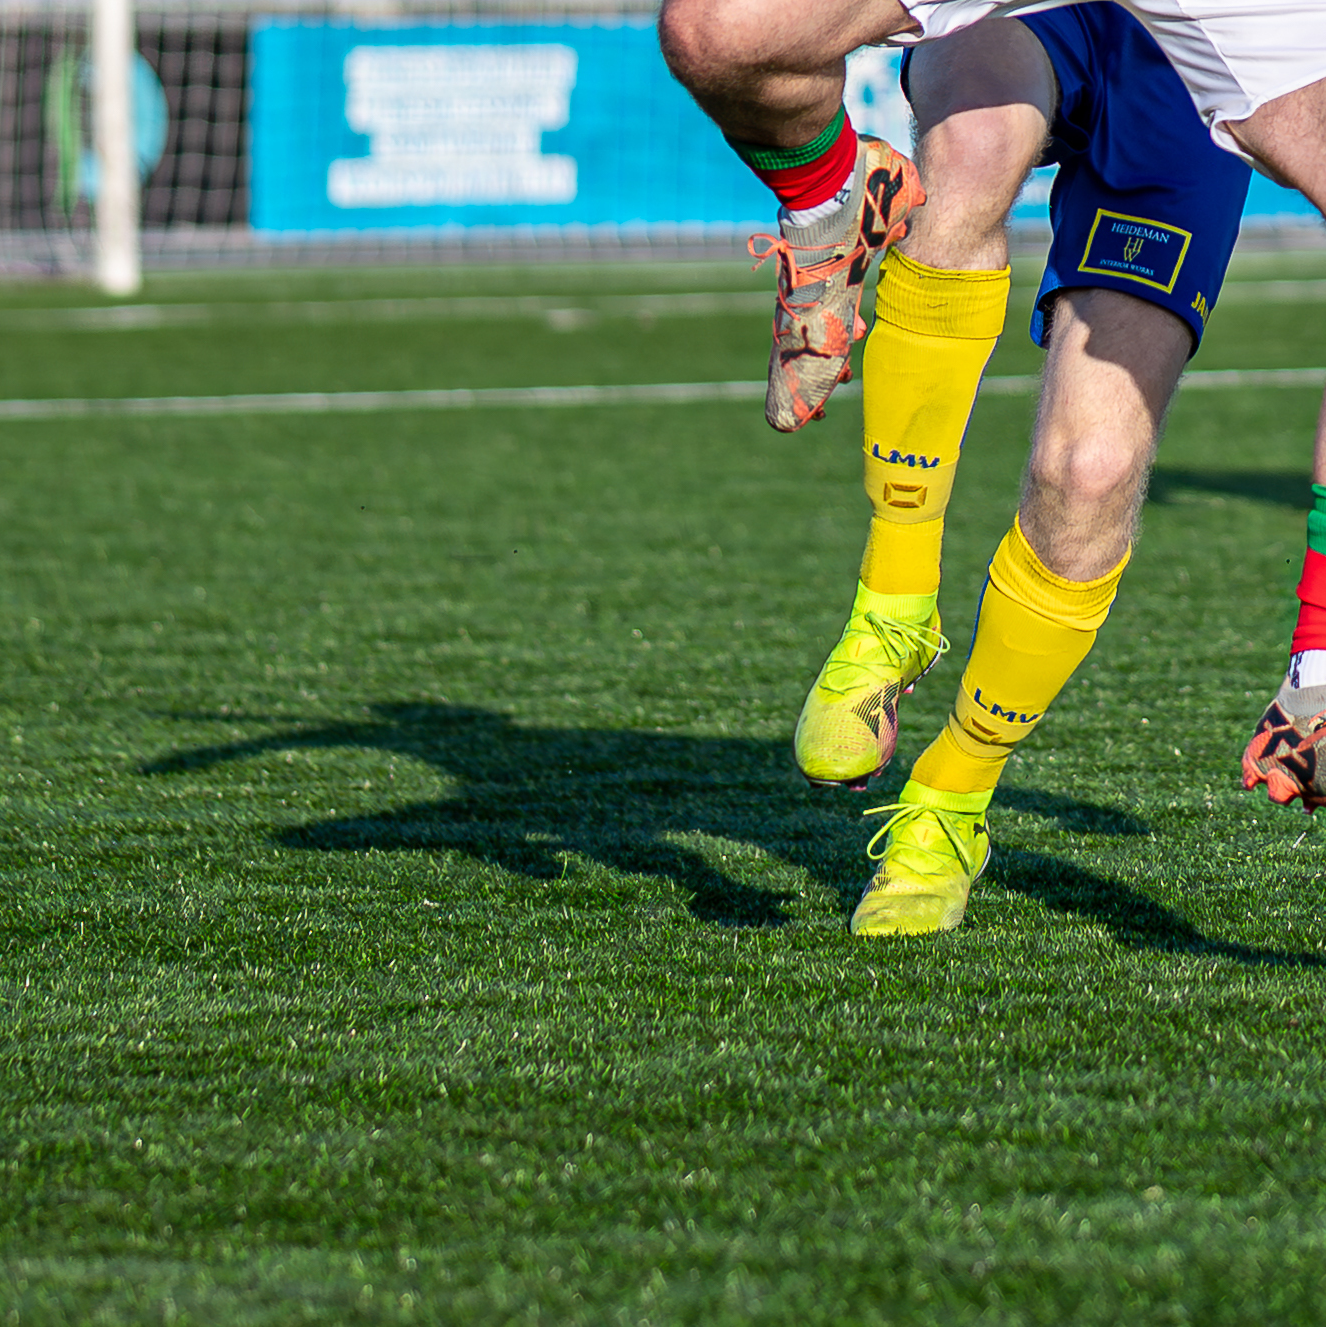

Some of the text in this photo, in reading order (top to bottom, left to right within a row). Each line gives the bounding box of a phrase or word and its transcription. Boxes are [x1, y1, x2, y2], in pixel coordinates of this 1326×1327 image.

[1111, 222, 1170, 244] HEIDEMAN
[872, 443, 940, 469] LMV
[974, 687, 1040, 724] LMV
